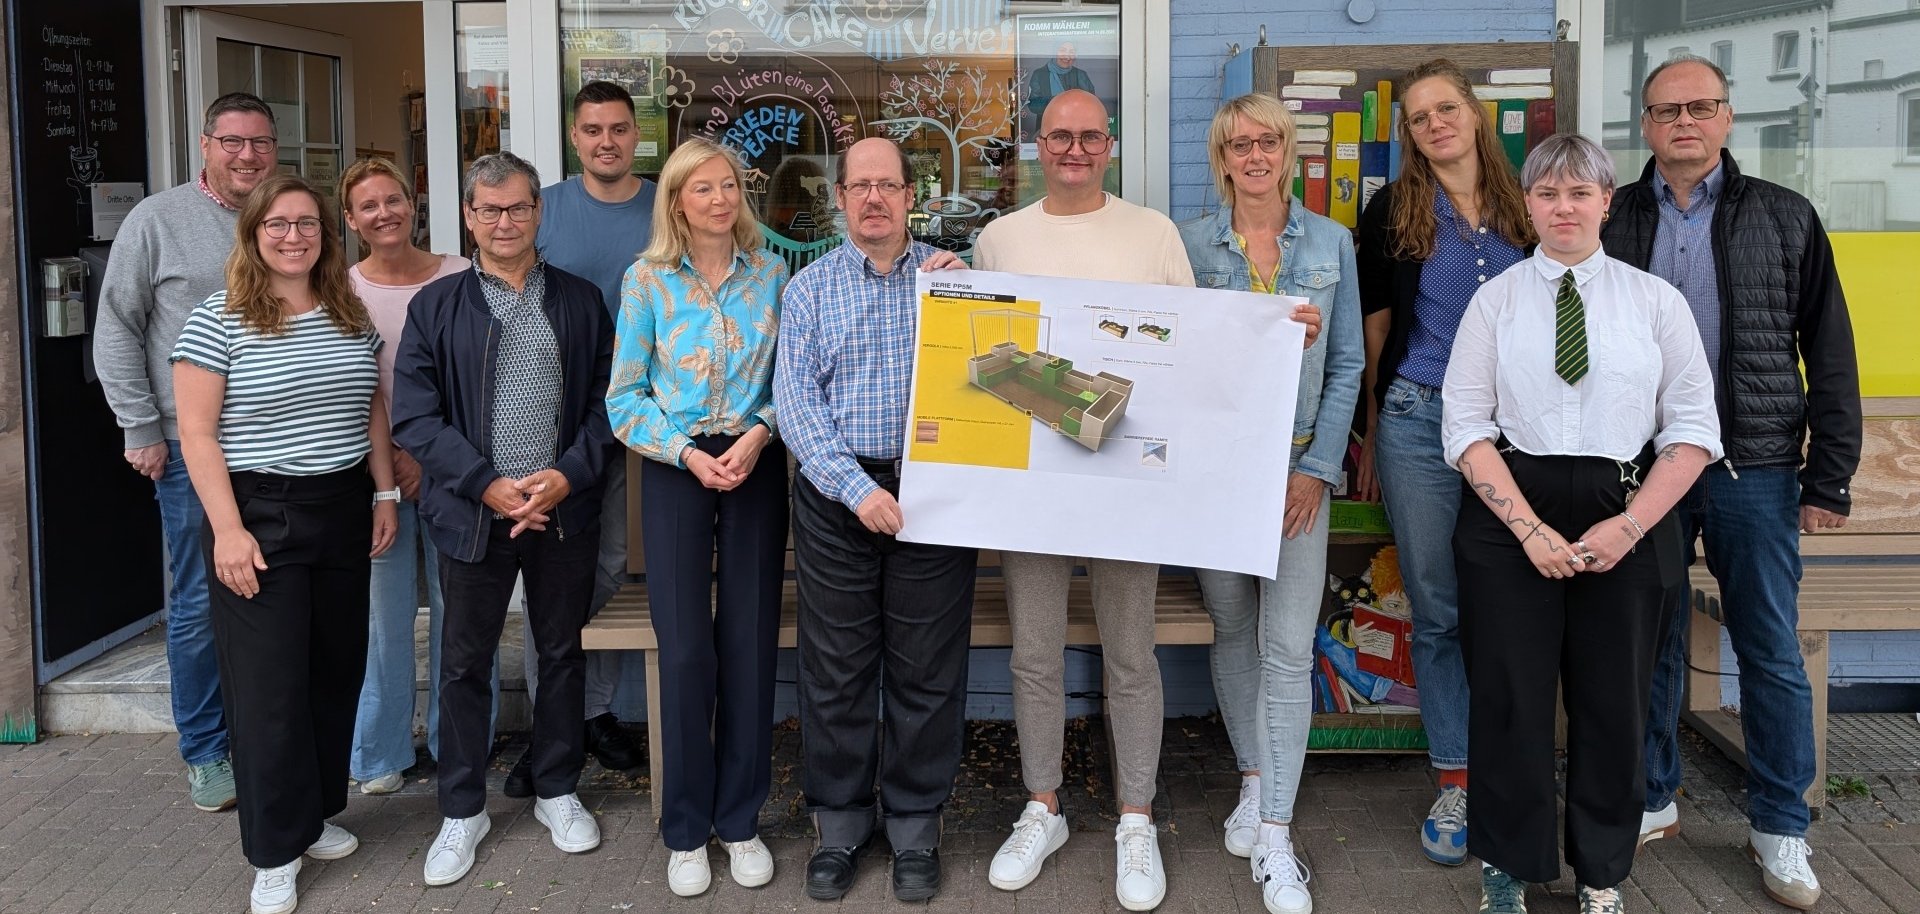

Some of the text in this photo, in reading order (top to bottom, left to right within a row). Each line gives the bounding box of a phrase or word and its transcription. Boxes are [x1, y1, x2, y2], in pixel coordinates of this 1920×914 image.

[1024, 20, 1090, 31] KOMM WÄHLEN!
[43, 57, 73, 75] Dienstag
[104, 61, 114, 73] Uhr
[46, 79, 76, 94] Mittwoch
[105, 79, 115, 91] Uhr
[711, 69, 782, 107] Blüten
[785, 71, 813, 94] eine
[47, 100, 71, 119] Freitag
[107, 99, 117, 112] Uhr
[1504, 113, 1522, 125] LOVE
[47, 122, 75, 137] Sonntag
[720, 105, 805, 153] FRIEDEN
[737, 125, 800, 169] PEACE
[123, 195, 135, 203] Orte
[931, 281, 951, 289] SERIE
